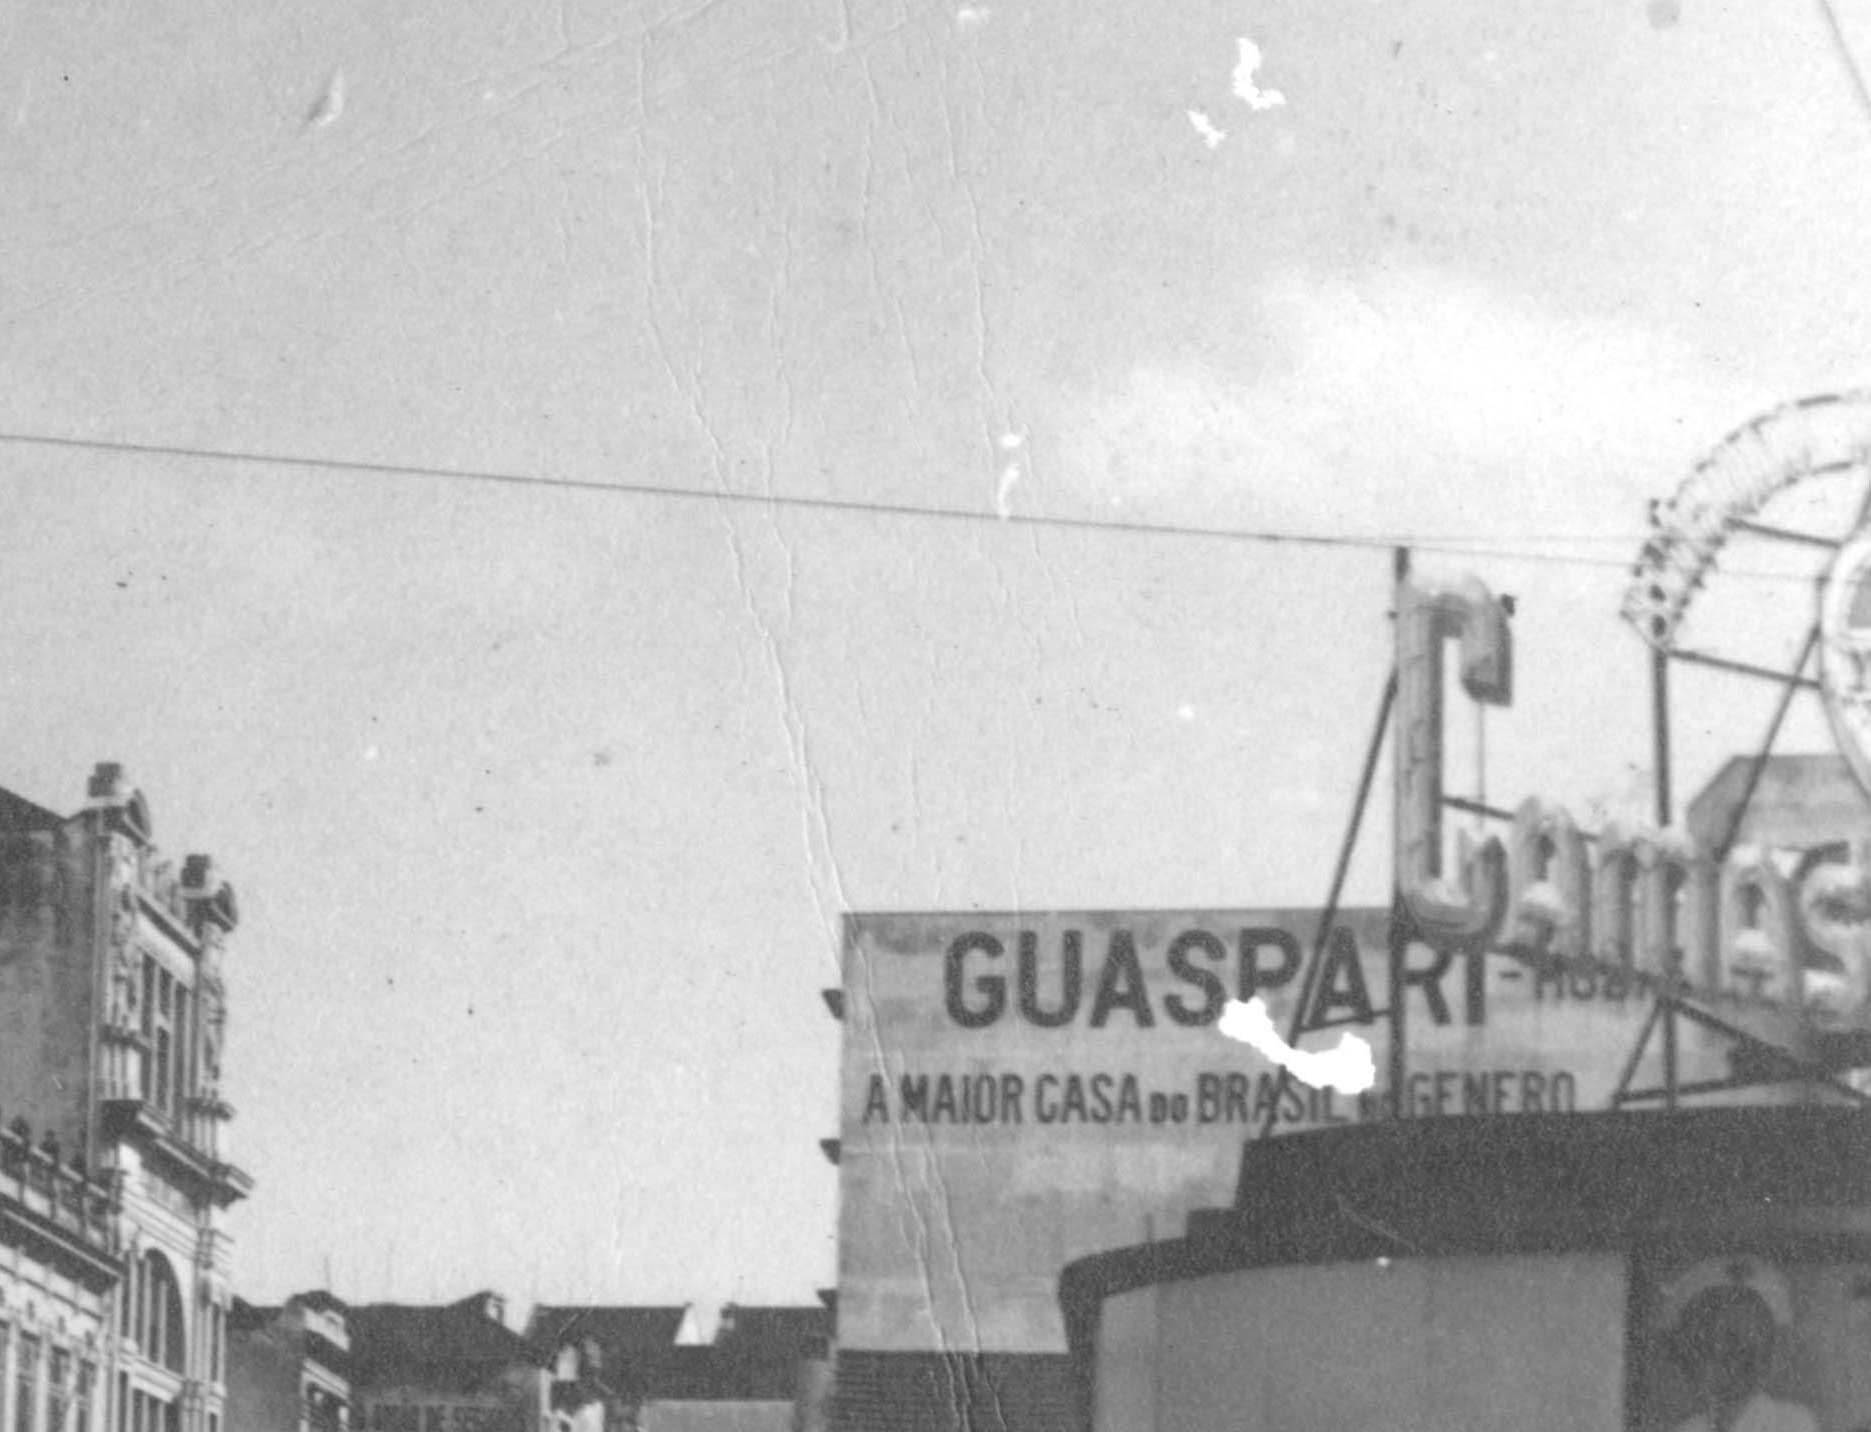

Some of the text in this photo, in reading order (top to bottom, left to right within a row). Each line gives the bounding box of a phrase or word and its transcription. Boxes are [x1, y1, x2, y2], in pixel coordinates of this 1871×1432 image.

[943, 925, 1487, 1029] GUASPARI
[862, 1074, 890, 1124] A
[899, 1073, 1024, 1124] MAIOR
[1034, 1073, 1141, 1124] CASA
[1196, 1072, 1349, 1124] BRASIL
[1408, 1070, 1577, 1117] GENERO
